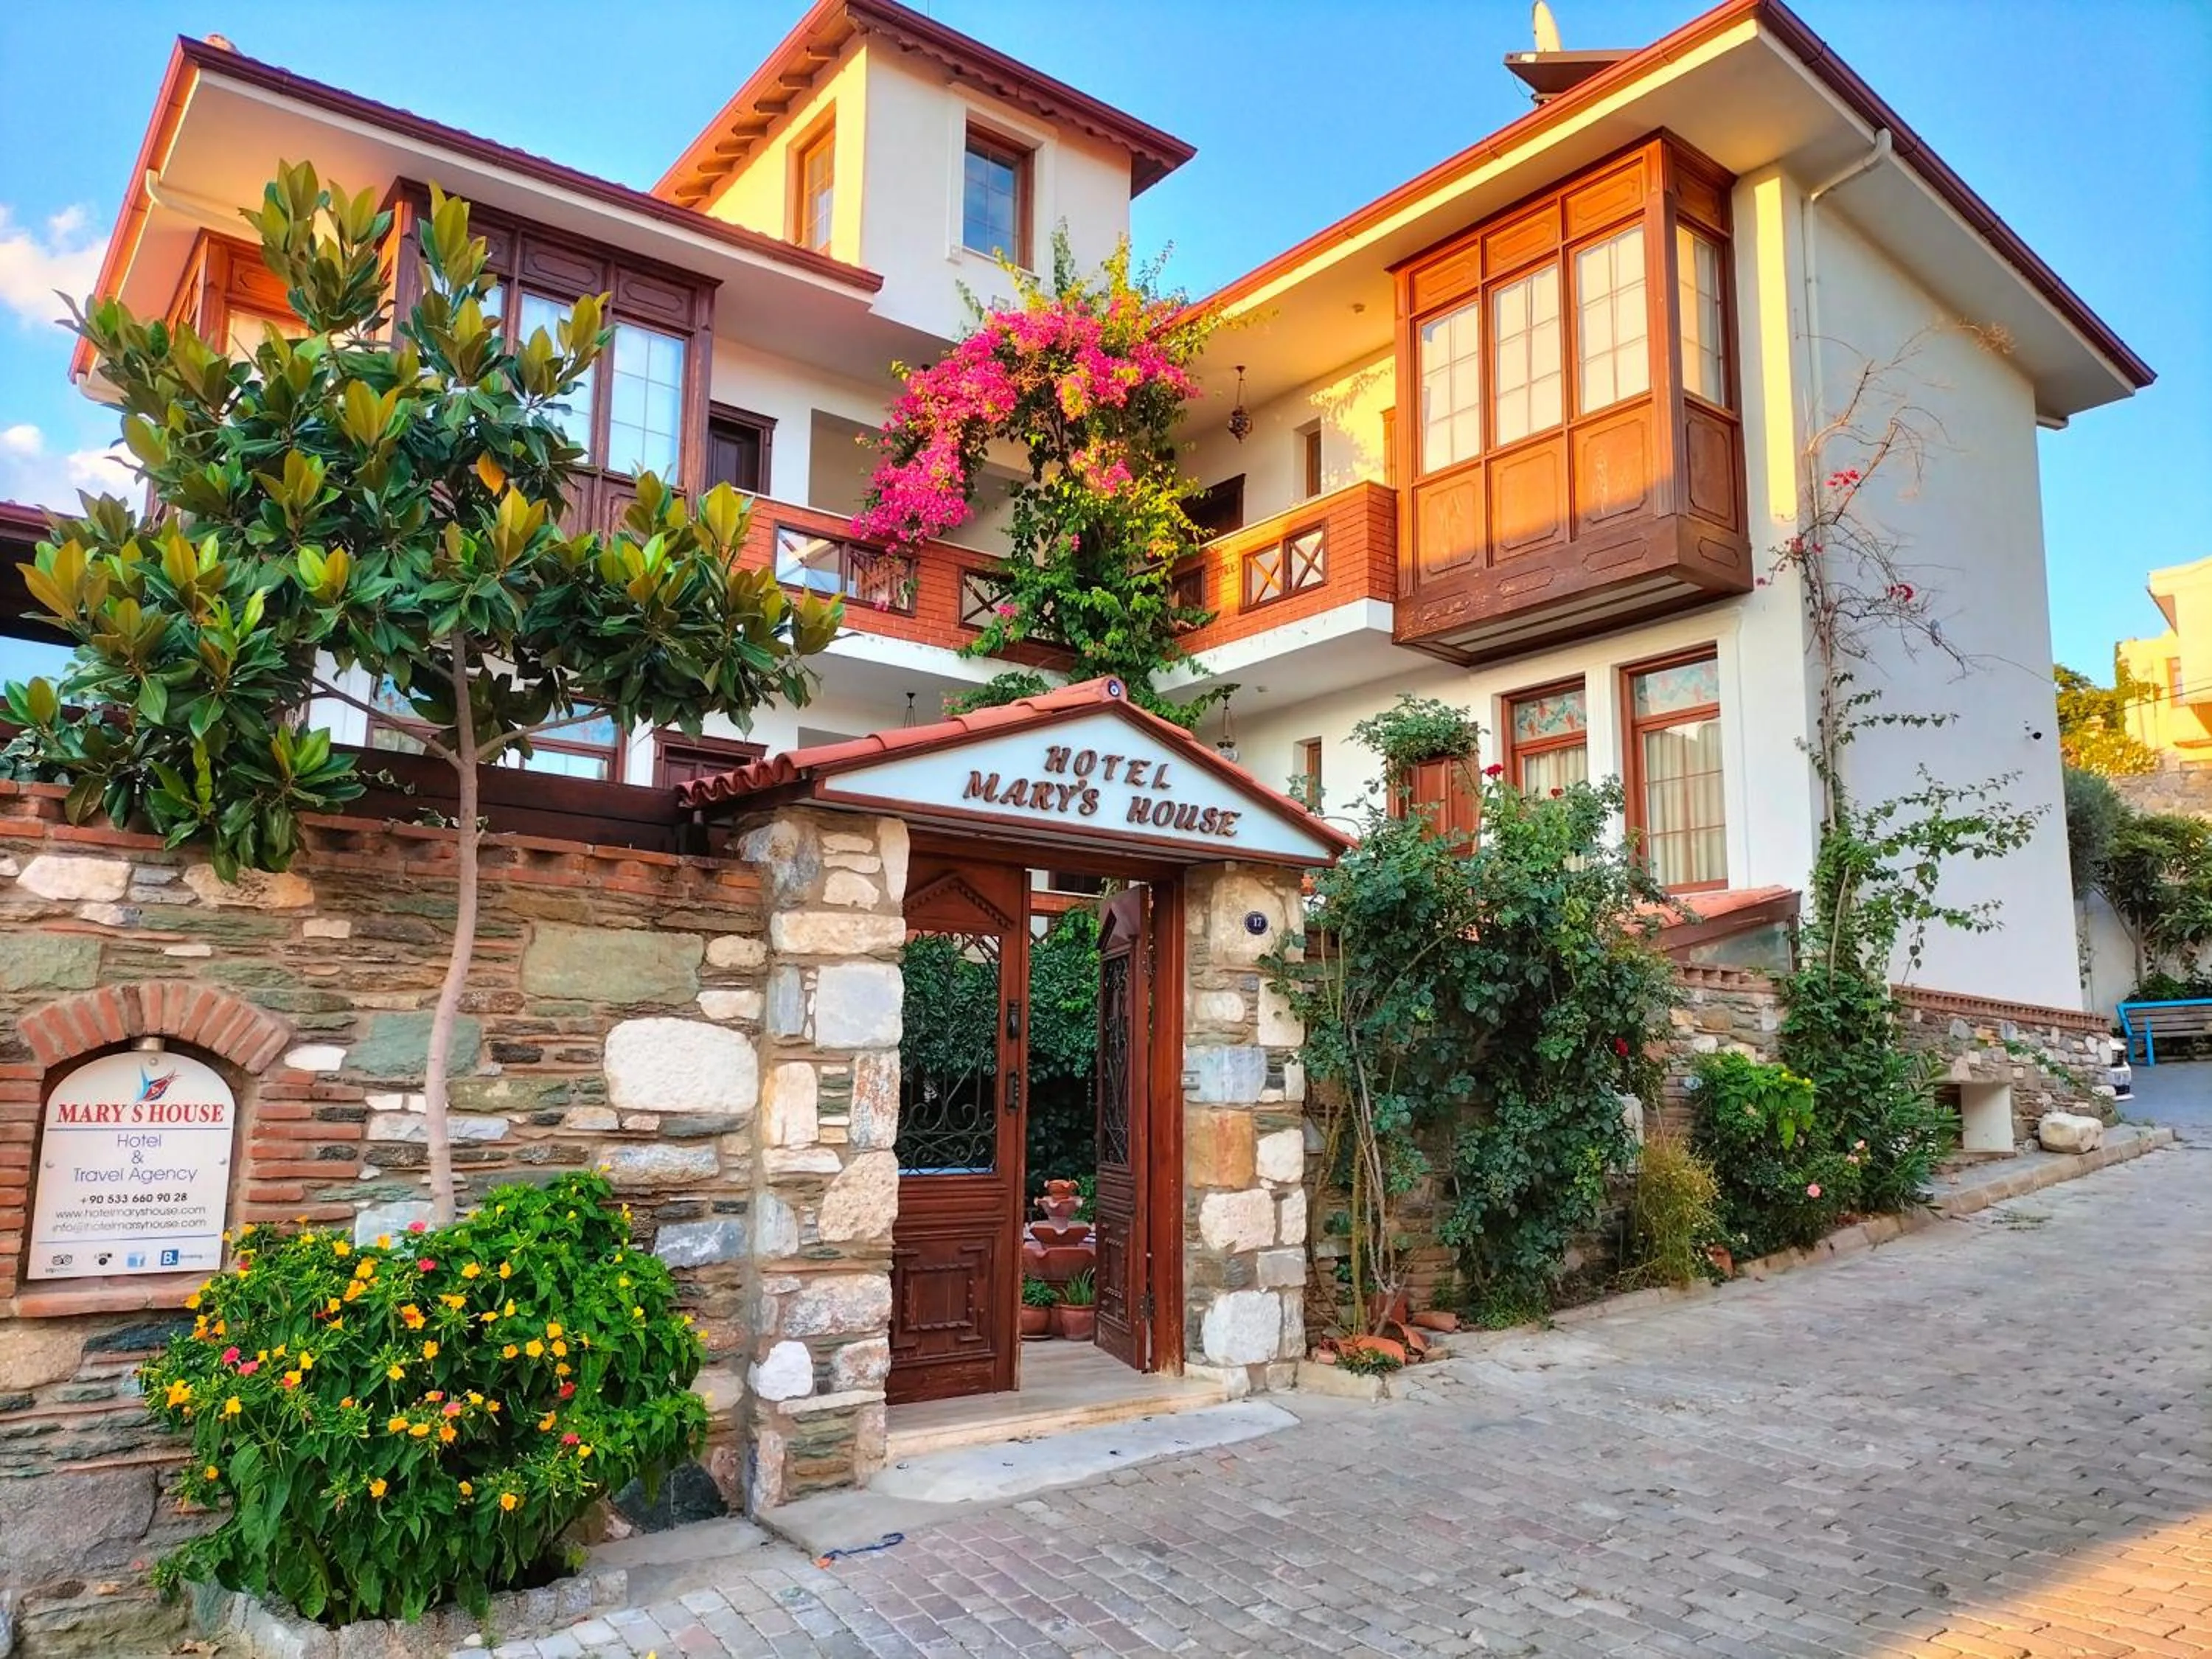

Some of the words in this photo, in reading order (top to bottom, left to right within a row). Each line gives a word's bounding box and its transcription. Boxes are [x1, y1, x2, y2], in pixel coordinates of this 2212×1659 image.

[1043, 745, 1172, 790] HOTEL
[962, 771, 1101, 816] MARY'S
[1126, 796, 1242, 837] HOUSE
[56, 1103, 143, 1122] MARYS
[147, 1103, 225, 1122] HOUSE
[116, 1133, 161, 1148] Hotel
[131, 1150, 144, 1164] &
[73, 1167, 124, 1183] Travel
[128, 1166, 198, 1184] Agency
[107, 1194, 128, 1204] 533
[132, 1193, 153, 1203] 660
[156, 1192, 170, 1203] 90
[173, 1192, 188, 1202] 28
